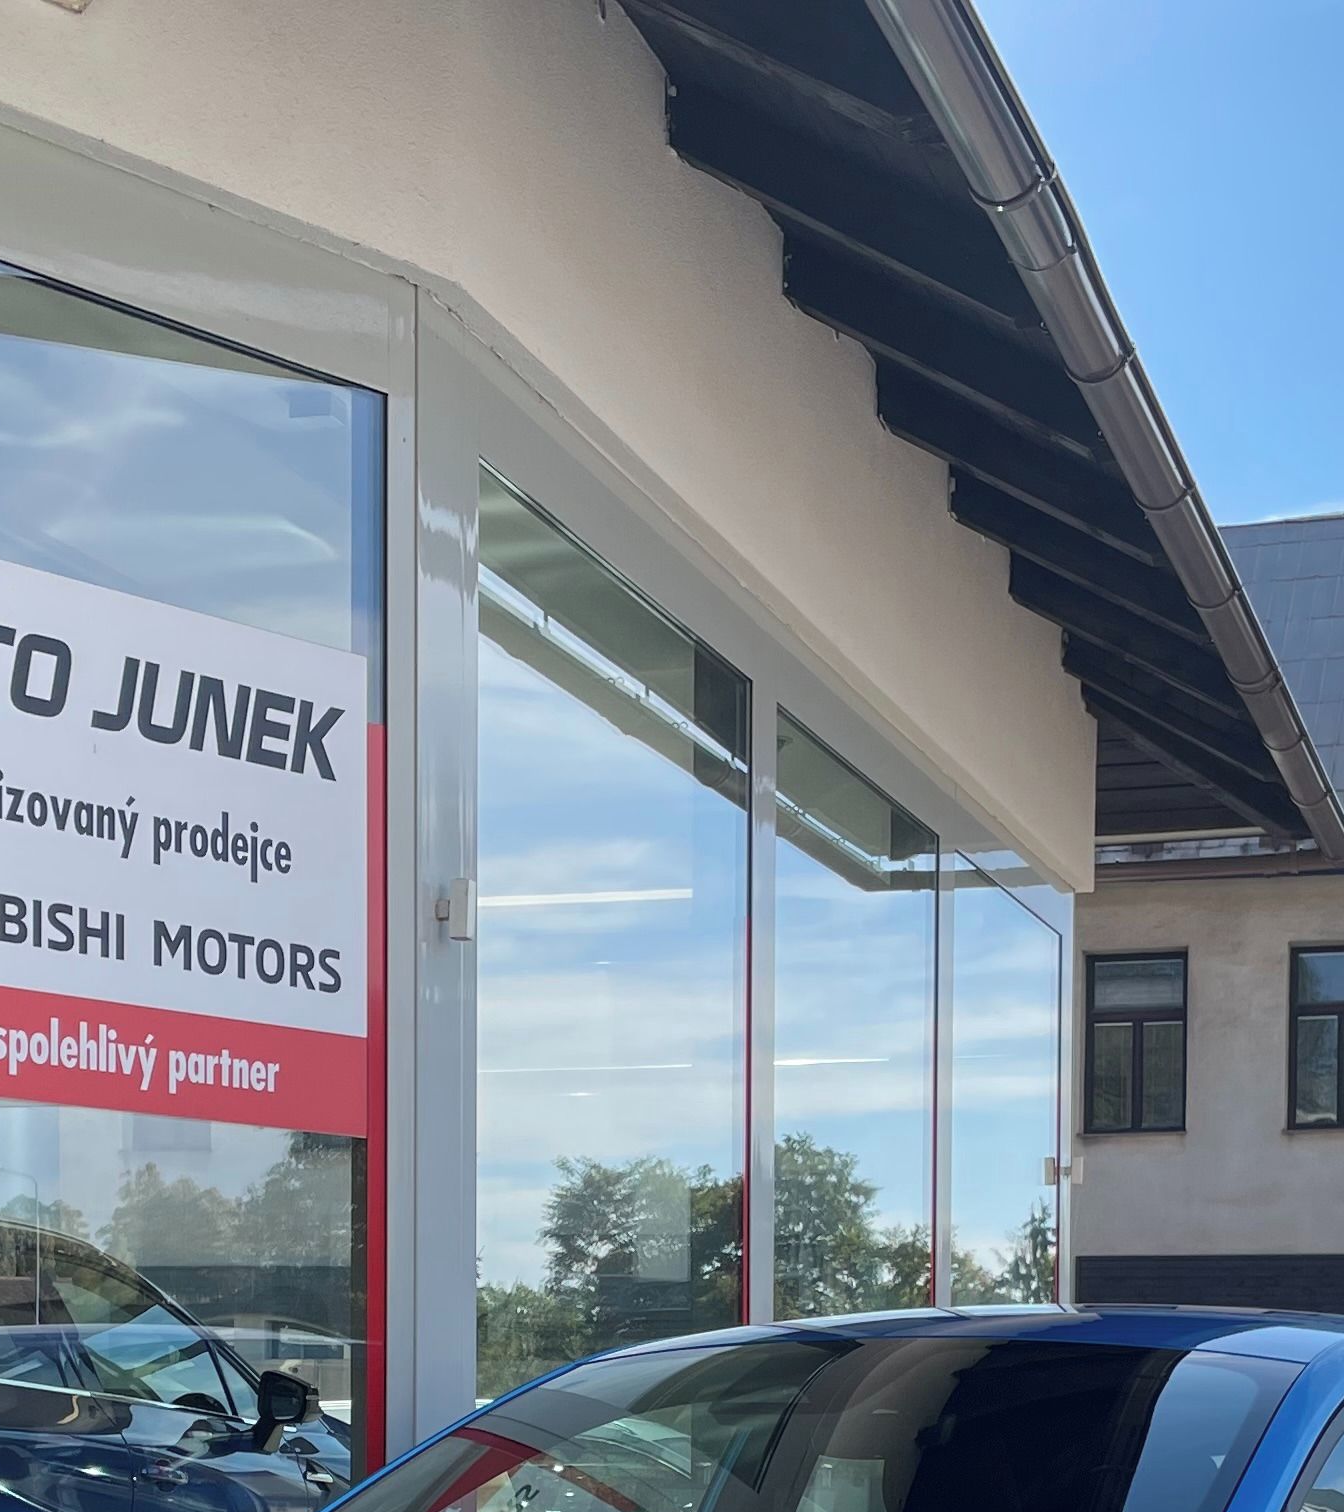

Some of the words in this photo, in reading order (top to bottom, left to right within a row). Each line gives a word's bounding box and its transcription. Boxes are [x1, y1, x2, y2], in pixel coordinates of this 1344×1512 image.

[91, 658, 345, 782] JUNEK
[152, 816, 293, 883] prodejce
[154, 920, 342, 994] MOTORS
[169, 1047, 280, 1094] partner
